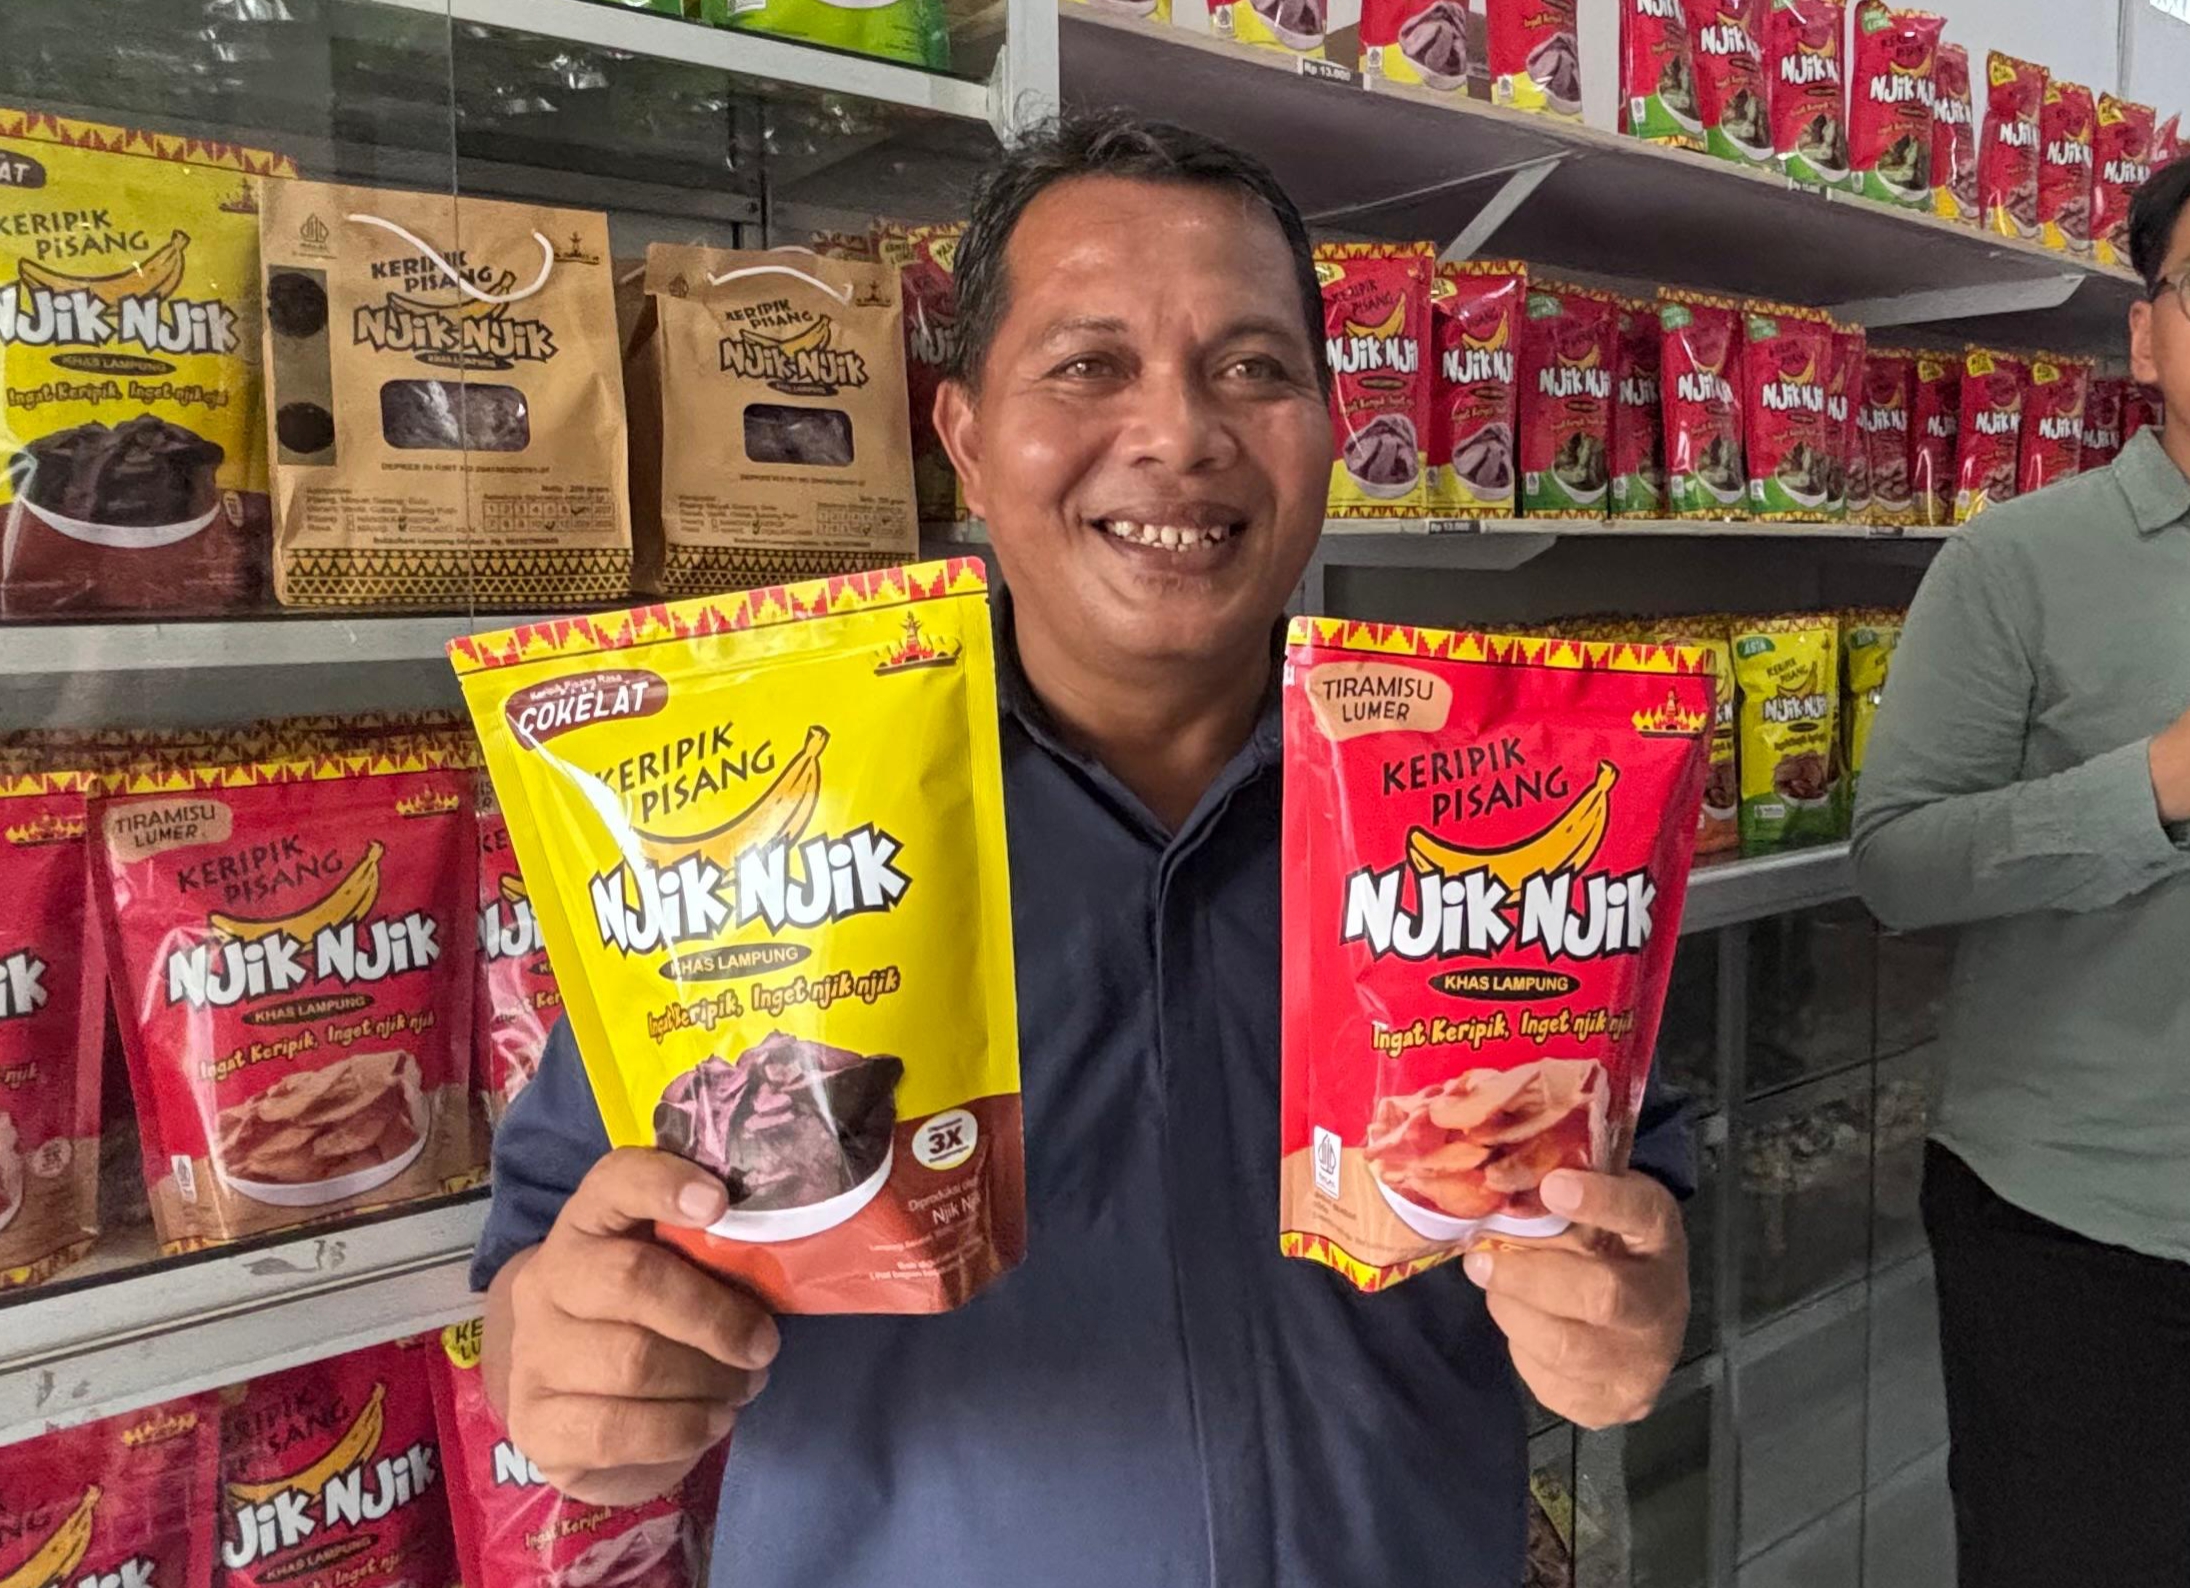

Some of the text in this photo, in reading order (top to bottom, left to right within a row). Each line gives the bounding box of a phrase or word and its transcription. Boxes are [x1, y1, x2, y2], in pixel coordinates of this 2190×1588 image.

[36, 230, 149, 261] PISANG
[518, 681, 649, 735] COKELAT
[1323, 676, 1434, 702] TIRAMISU
[1342, 700, 1410, 723] LUMER
[641, 740, 776, 824] PISANG
[1382, 737, 1526, 796] KERIPIK
[1431, 765, 1569, 827] PISANG
[116, 805, 215, 833] TIRAMISU
[134, 824, 198, 848] LUMER
[178, 835, 304, 893] KERIPIK
[223, 850, 344, 904] PISANG
[717, 947, 800, 971] LAMPUNG
[751, 977, 808, 1016] Inget
[810, 970, 854, 1009] njik
[855, 966, 901, 1004] njik
[1445, 975, 1569, 992] KHAS LAMPUNG
[254, 996, 367, 1023] KHAS LAMPUNG
[1372, 1020, 1427, 1057] Ingat
[1430, 1013, 1510, 1050] Keripik,
[1520, 1010, 1570, 1044] Inget
[1572, 1008, 1606, 1042] njik
[928, 1126, 964, 1155] 3X
[221, 1486, 317, 1569] JiK
